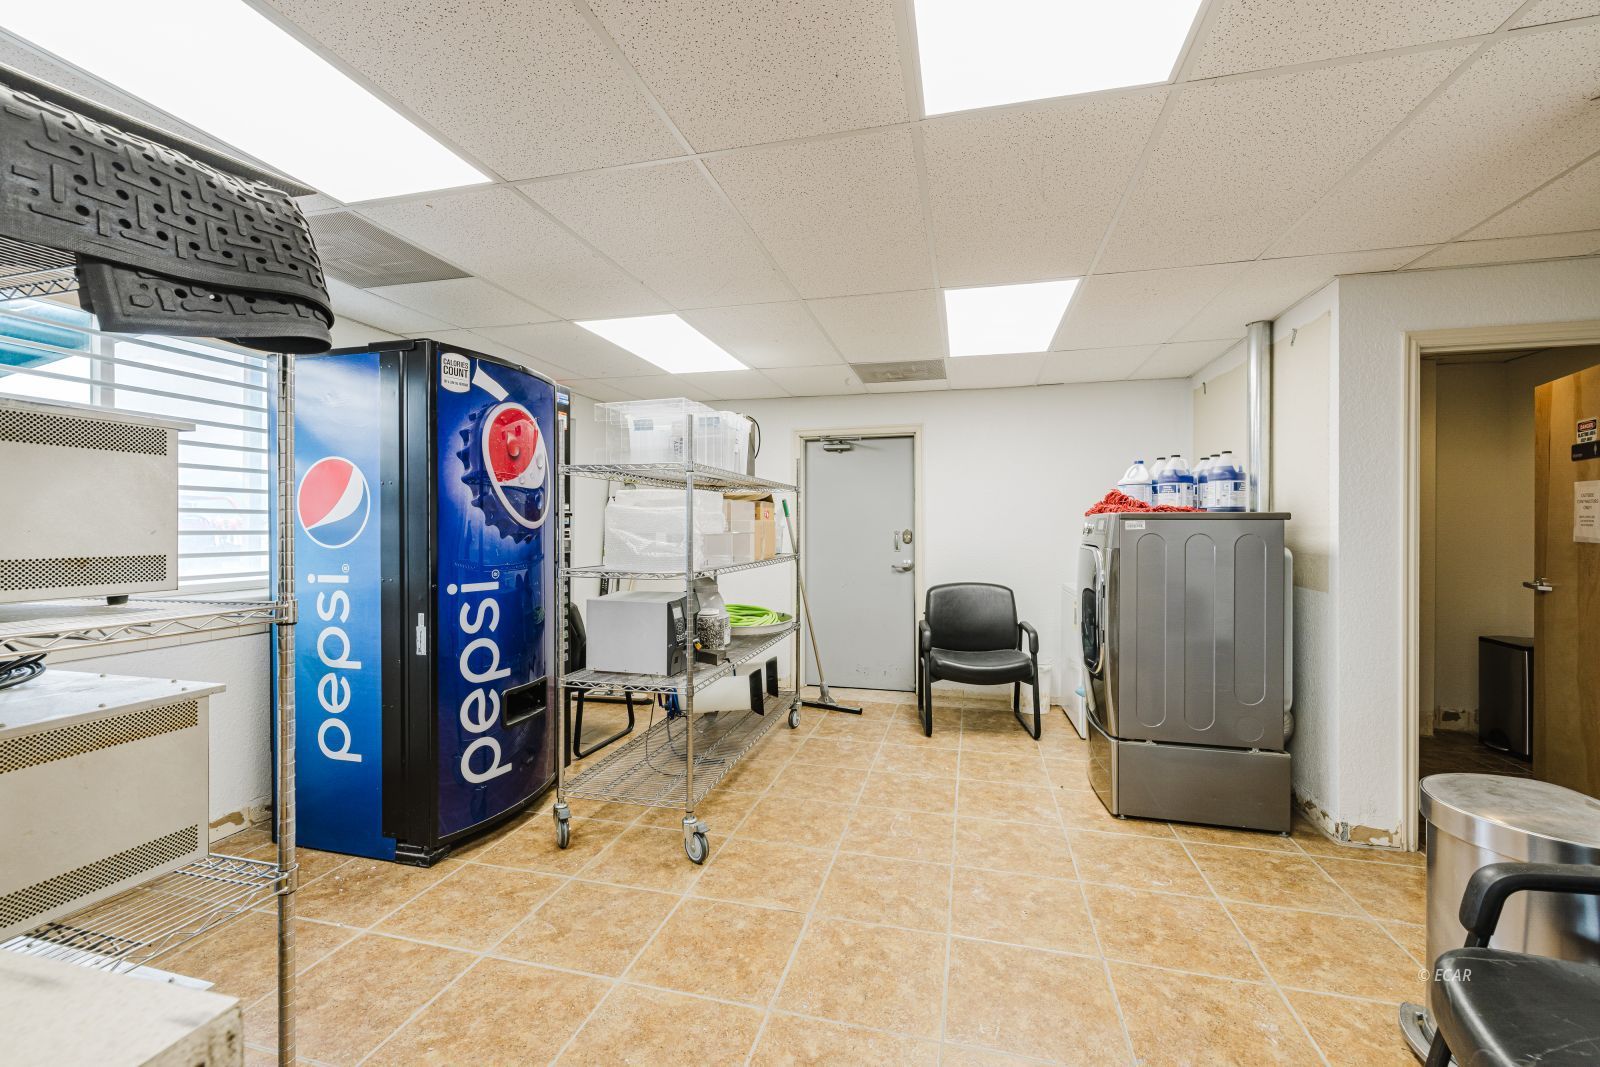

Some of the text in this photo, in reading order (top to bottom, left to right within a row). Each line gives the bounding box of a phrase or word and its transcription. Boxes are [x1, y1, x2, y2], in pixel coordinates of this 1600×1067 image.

[443, 358, 469, 369] CALORIES
[443, 365, 469, 378] COUNT
[307, 572, 362, 762] pepsi
[446, 580, 514, 784] pepsi
